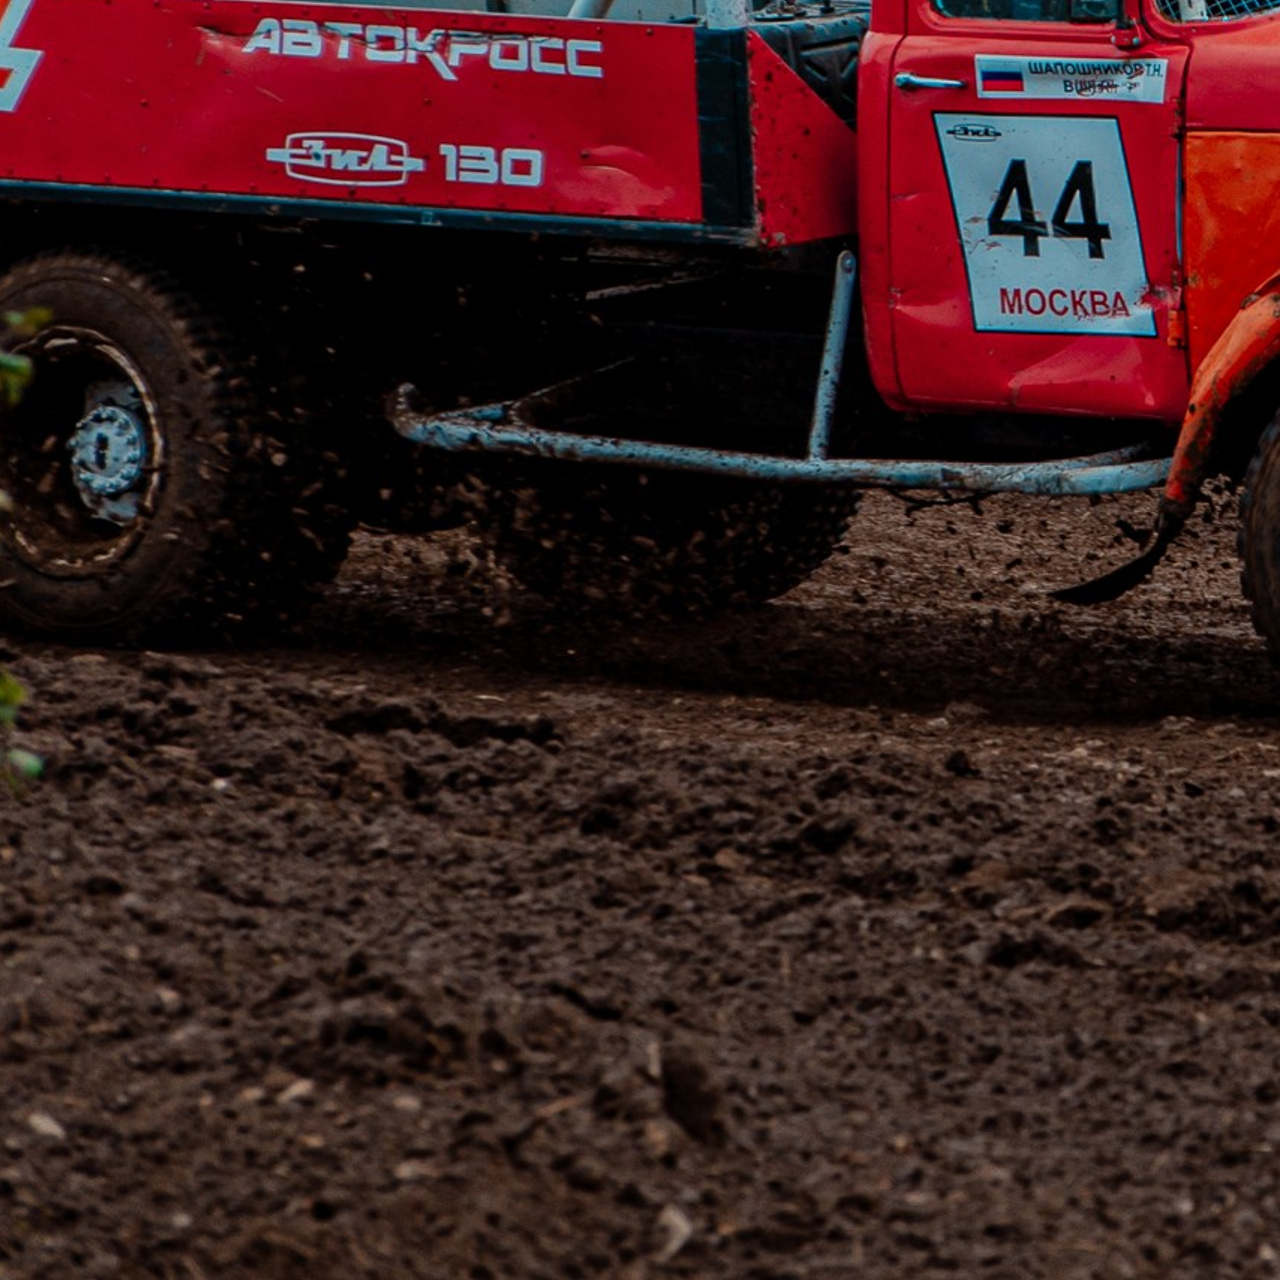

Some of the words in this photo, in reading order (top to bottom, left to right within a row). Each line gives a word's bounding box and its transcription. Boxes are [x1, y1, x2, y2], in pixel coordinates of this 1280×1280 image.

[241, 18, 604, 81] АВТОКРОСС
[440, 144, 543, 186] 130
[987, 158, 1112, 260] 44
[999, 287, 1131, 317] МОСКВА
